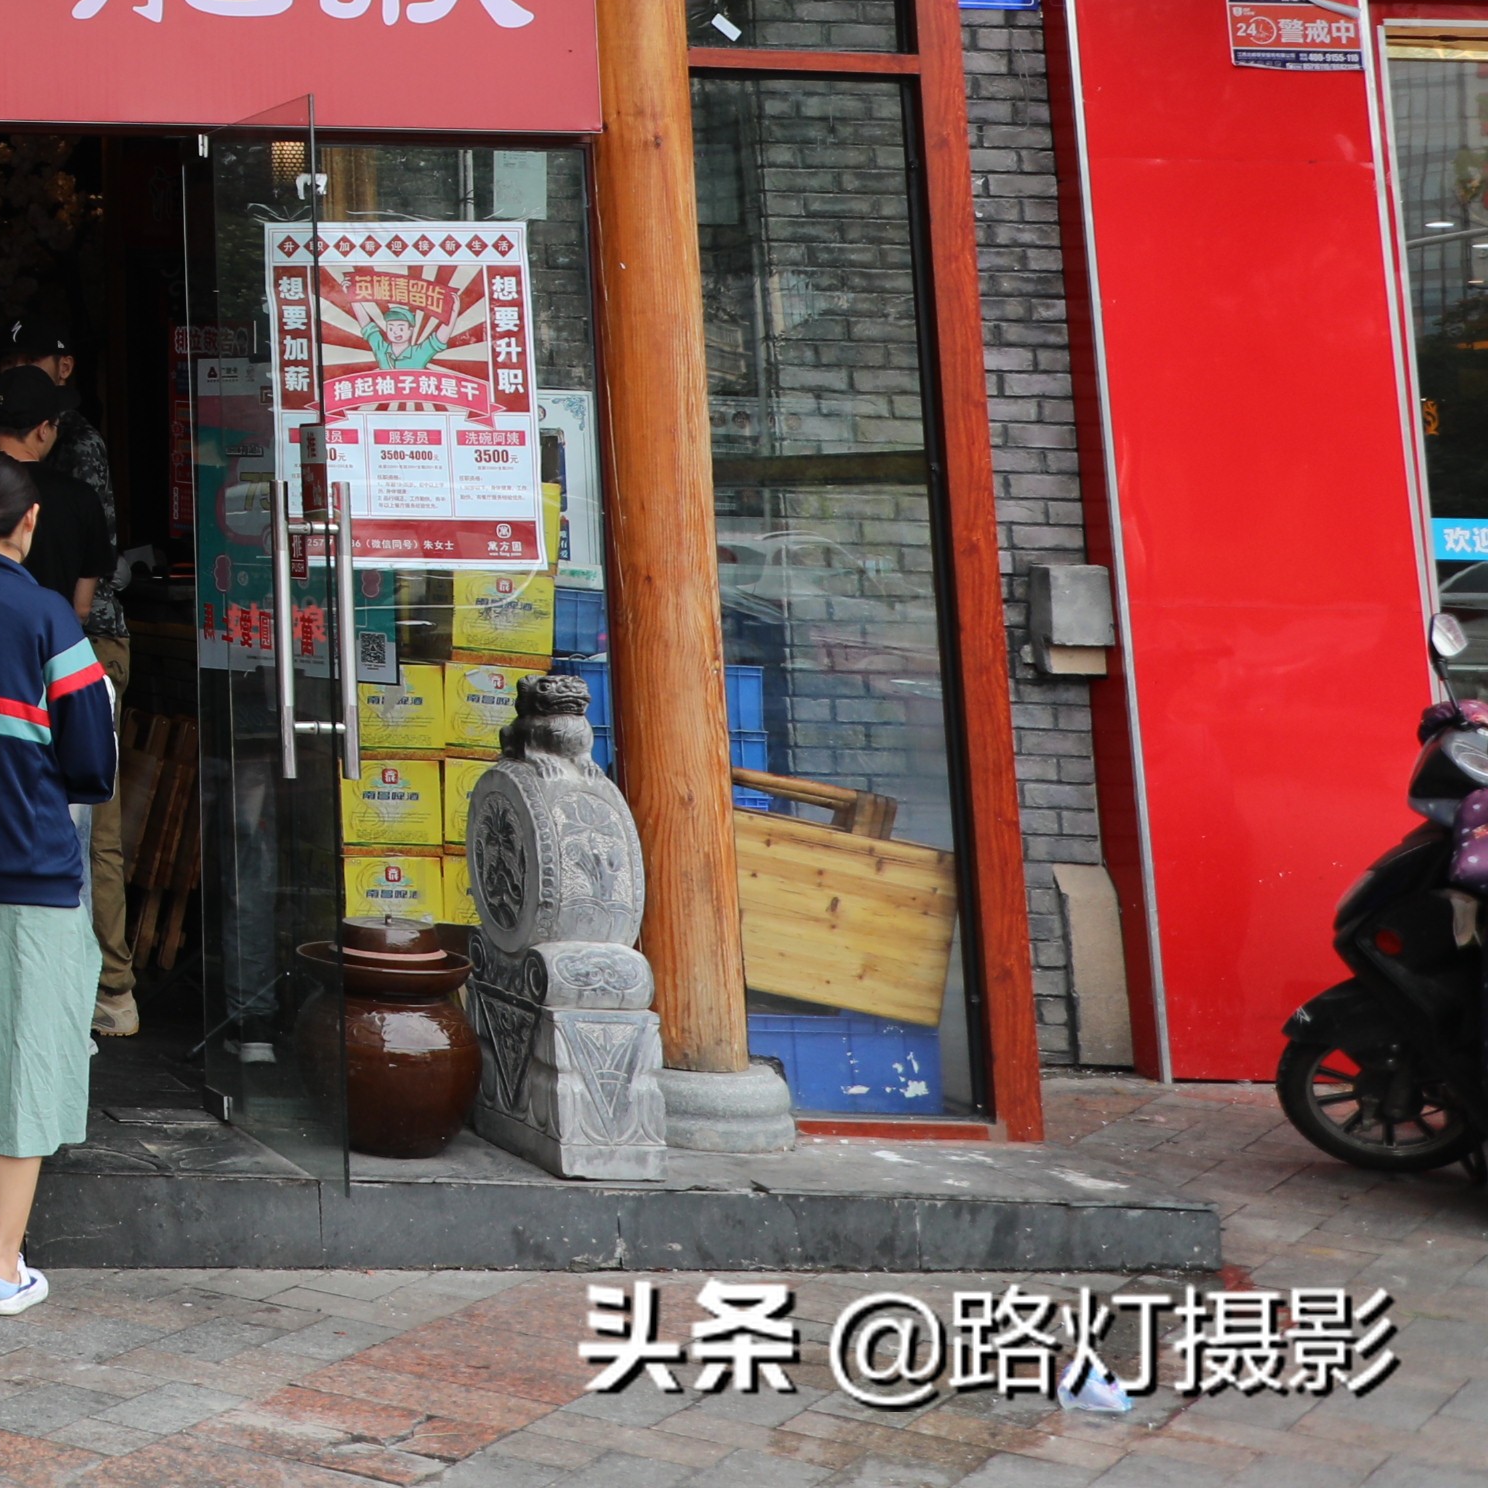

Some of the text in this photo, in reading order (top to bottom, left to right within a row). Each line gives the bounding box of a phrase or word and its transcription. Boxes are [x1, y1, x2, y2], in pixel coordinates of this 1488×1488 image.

[1236, 19, 1355, 44] 24 警戒中
[354, 275, 444, 312] 英雄请留步
[278, 276, 310, 392] 想要加薪
[492, 276, 524, 394] 想要升职
[334, 374, 480, 402] 撸起袖子就是干
[389, 431, 428, 444] 服务员
[465, 432, 519, 445] 洗碗阿姨
[423, 539, 454, 550] 朱女士
